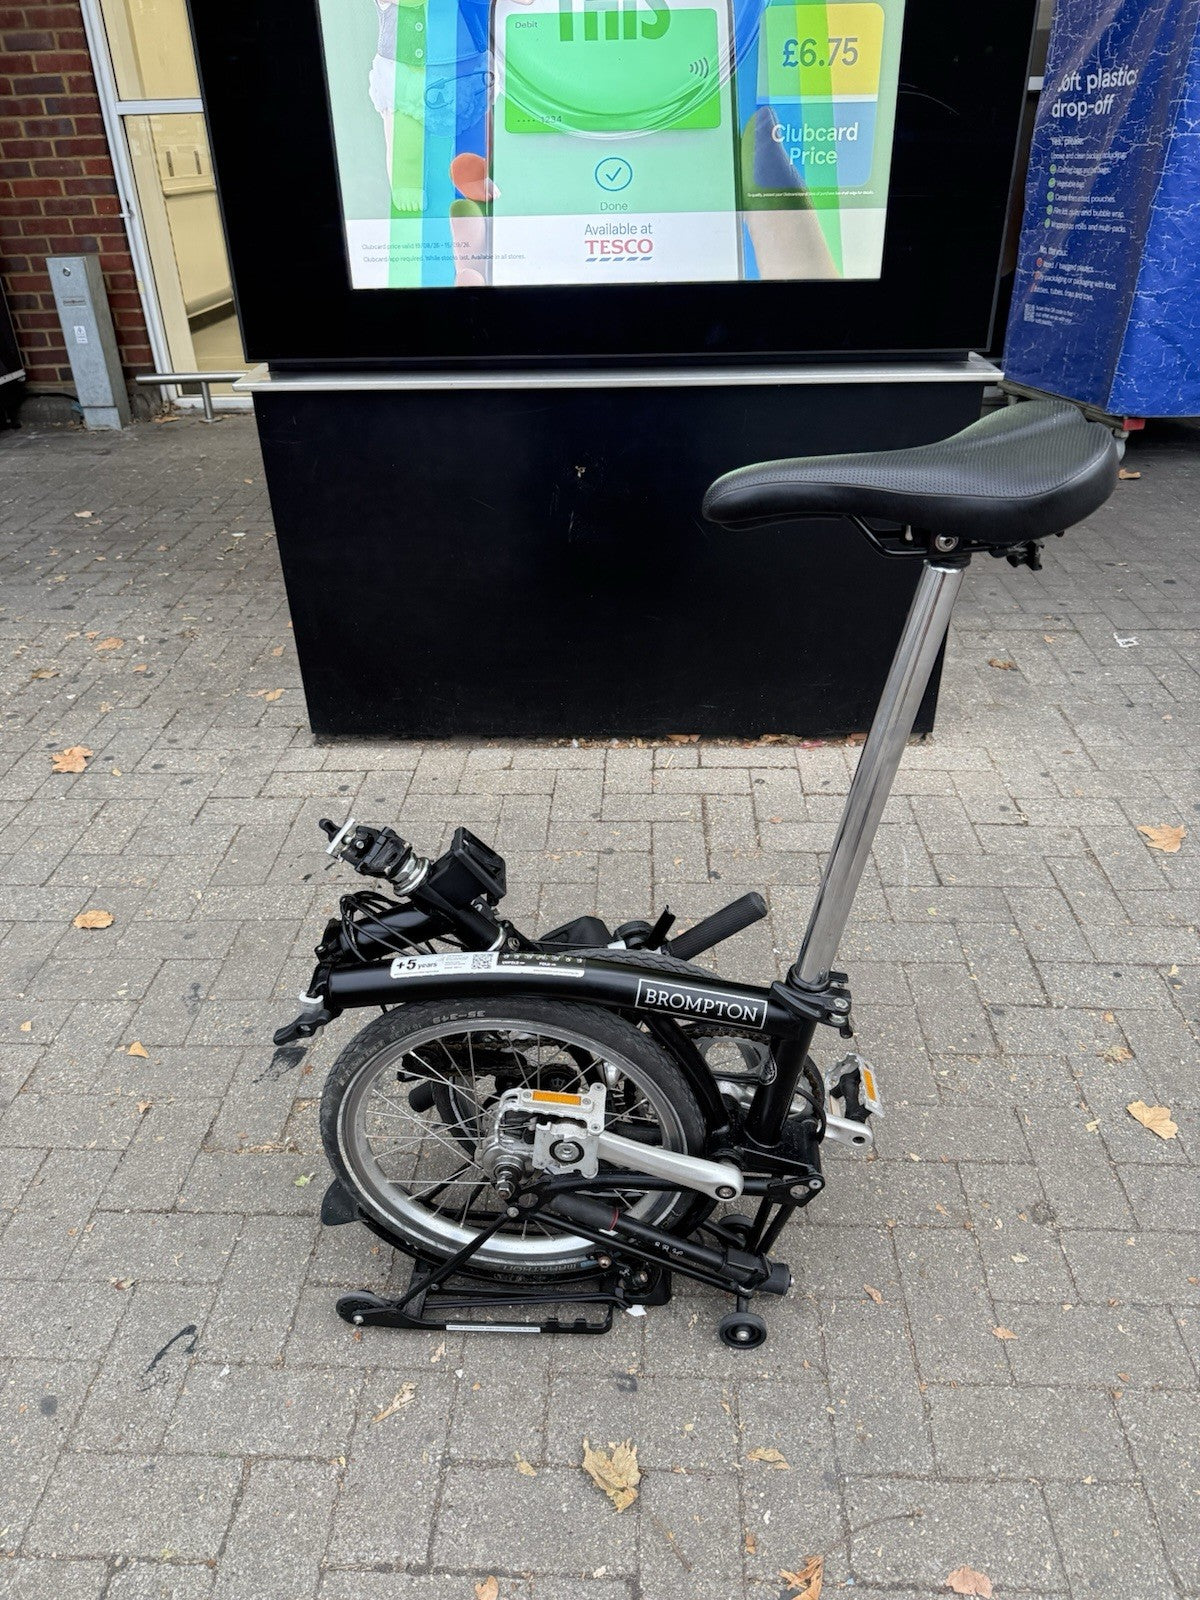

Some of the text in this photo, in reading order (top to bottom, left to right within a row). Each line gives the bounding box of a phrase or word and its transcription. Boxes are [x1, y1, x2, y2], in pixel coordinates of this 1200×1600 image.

[515, 21, 538, 29] Debit
[782, 37, 858, 67] £6.75
[1052, 94, 1115, 121] drop-off
[541, 115, 562, 124] 1234
[771, 122, 859, 143] Clubcard
[790, 147, 838, 165] Price
[600, 202, 628, 211] Done
[584, 223, 653, 235] Available at
[584, 238, 654, 255] TESCO
[417, 962, 437, 970] years
[644, 988, 758, 1021] BROMPTON
